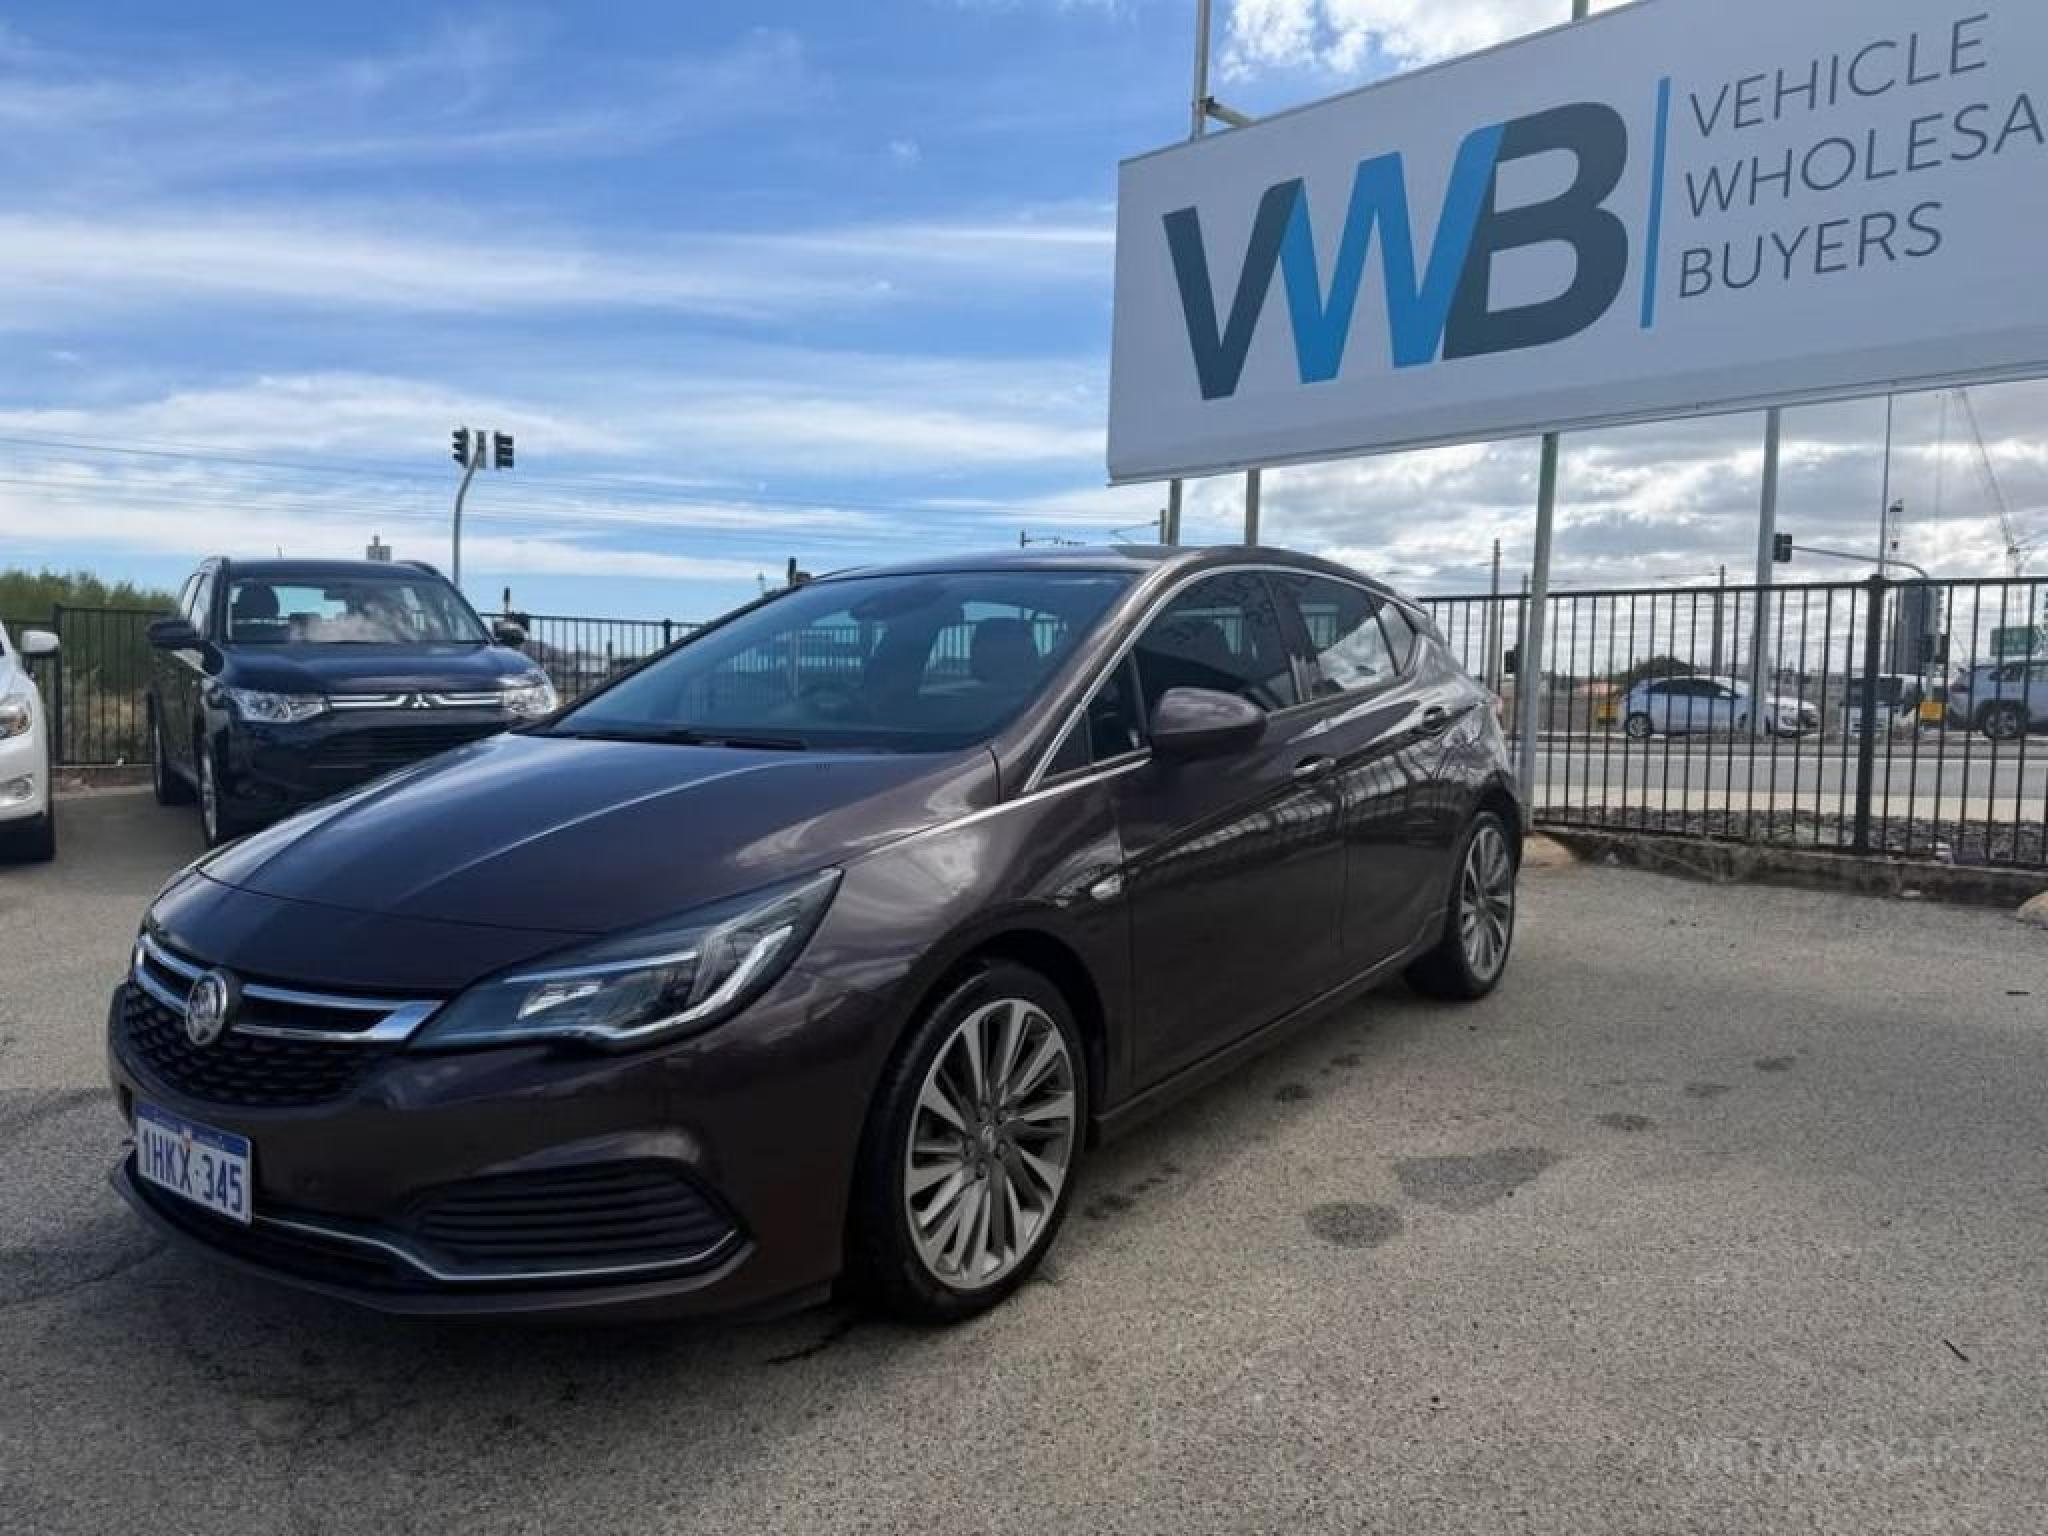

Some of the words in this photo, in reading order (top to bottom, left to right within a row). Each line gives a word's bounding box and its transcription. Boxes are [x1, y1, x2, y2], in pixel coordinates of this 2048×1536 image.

[1689, 12, 1988, 137] VEHICLE
[1686, 93, 2044, 218] WHOLESA
[1161, 101, 1629, 401] VWB
[1680, 202, 1942, 298] BUYERS
